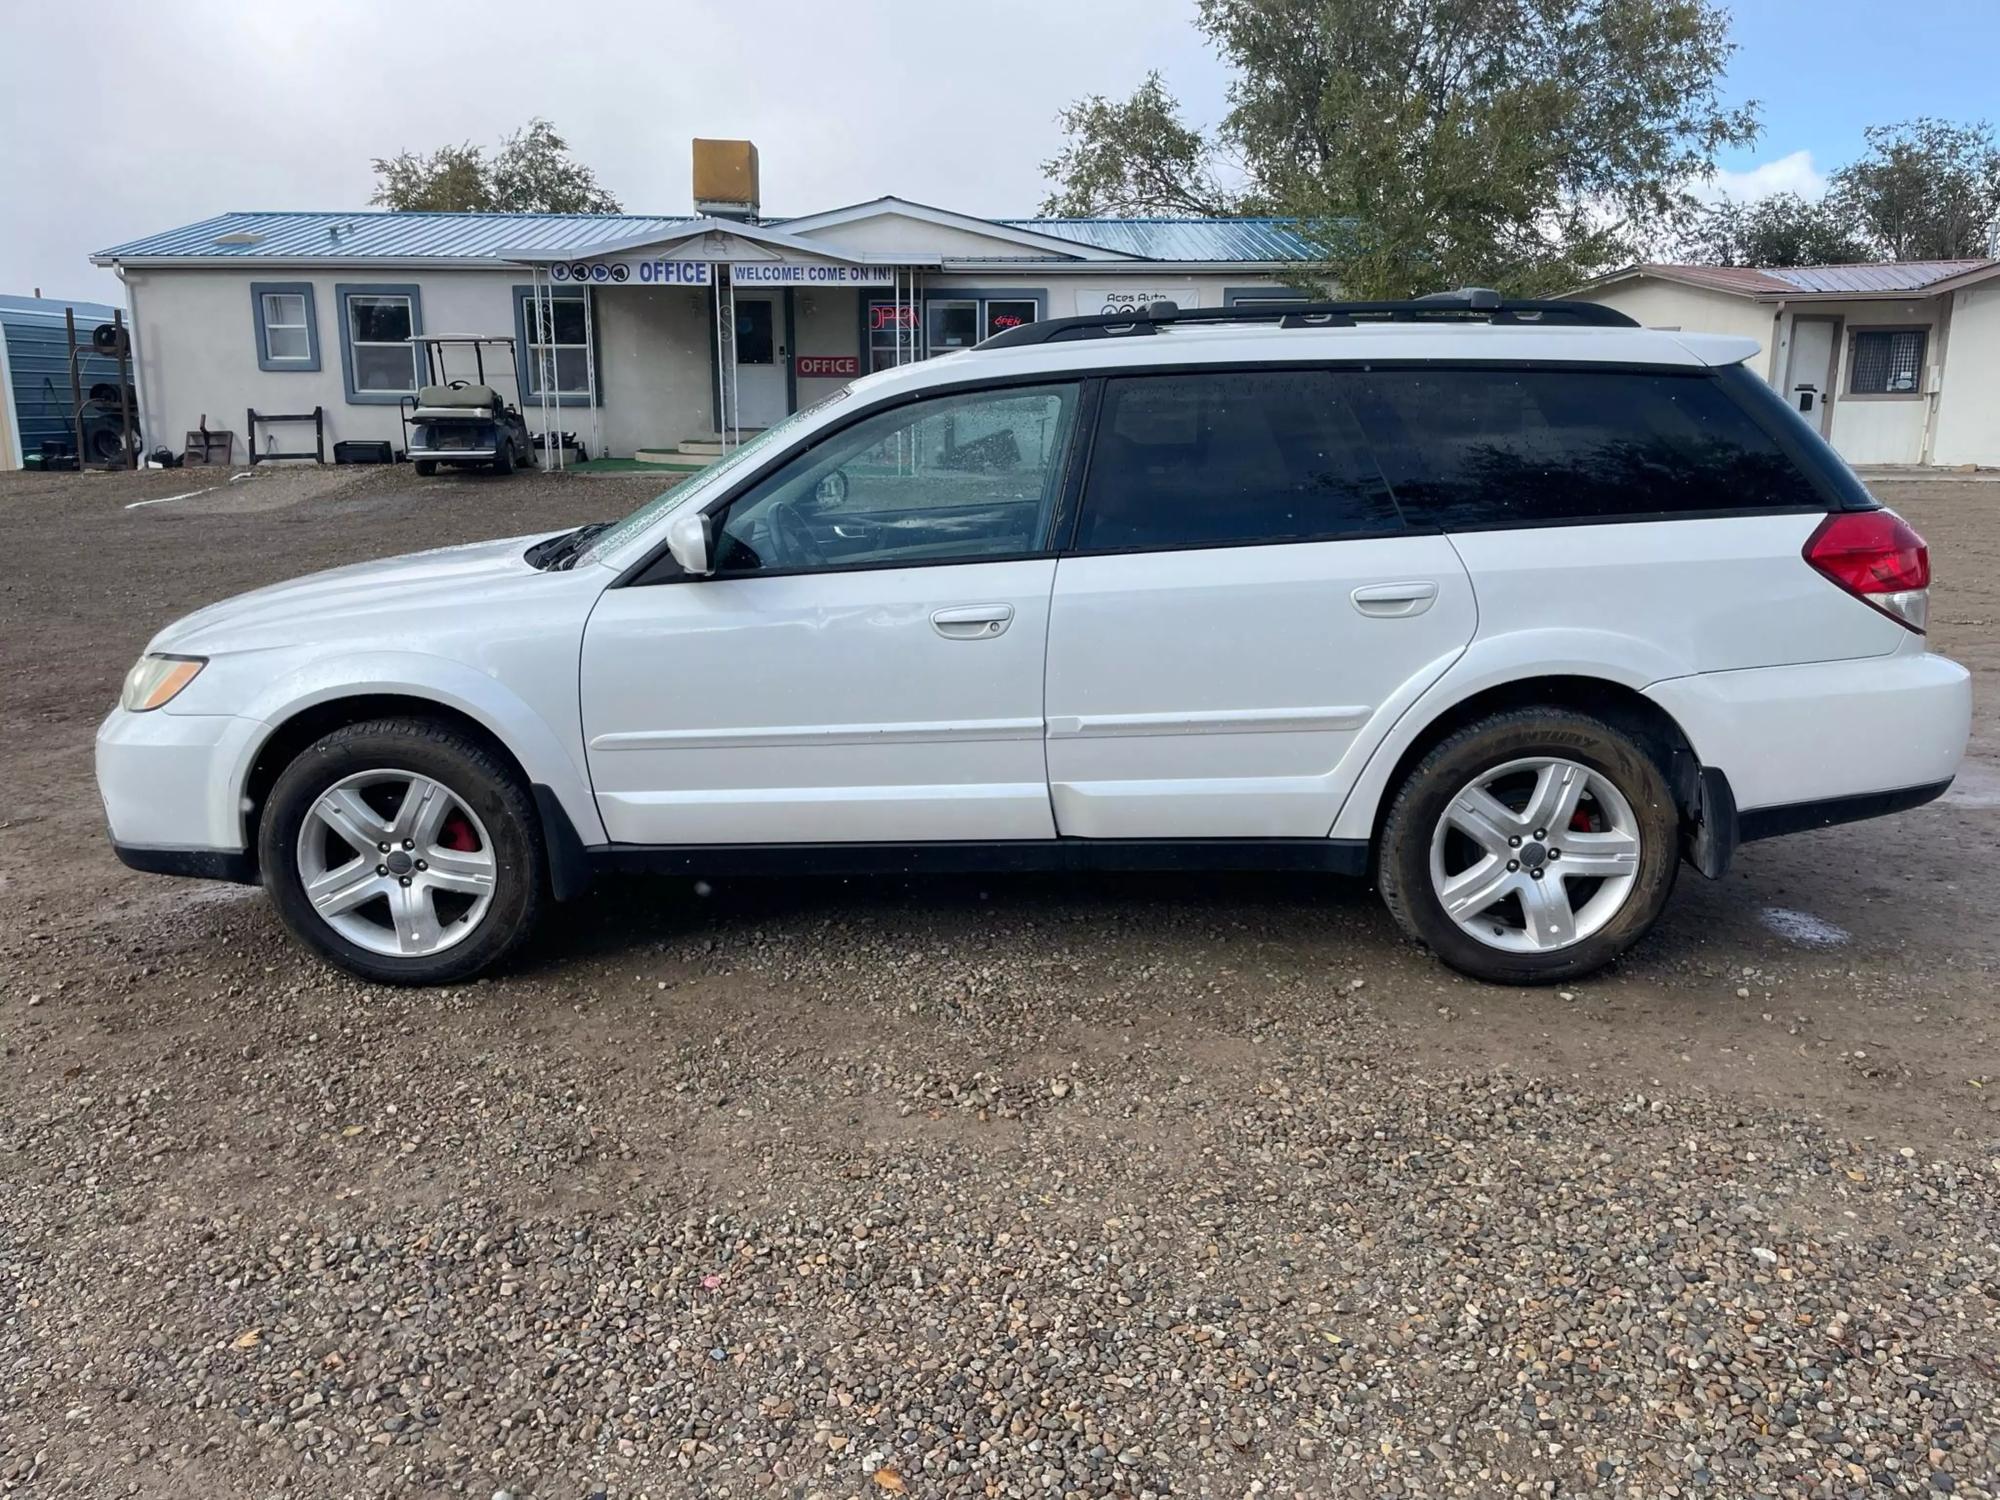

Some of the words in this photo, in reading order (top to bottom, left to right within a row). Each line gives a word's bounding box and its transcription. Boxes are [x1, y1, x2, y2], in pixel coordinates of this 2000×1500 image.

[639, 262, 707, 283] OFFICE
[734, 266, 804, 281] WELCOME!
[808, 266, 846, 281] COME
[850, 266, 869, 281] ON
[873, 266, 891, 281] IN!
[1107, 293, 1135, 302] Aces
[993, 315, 1021, 326] OPEN
[801, 359, 855, 373] OFFICE
